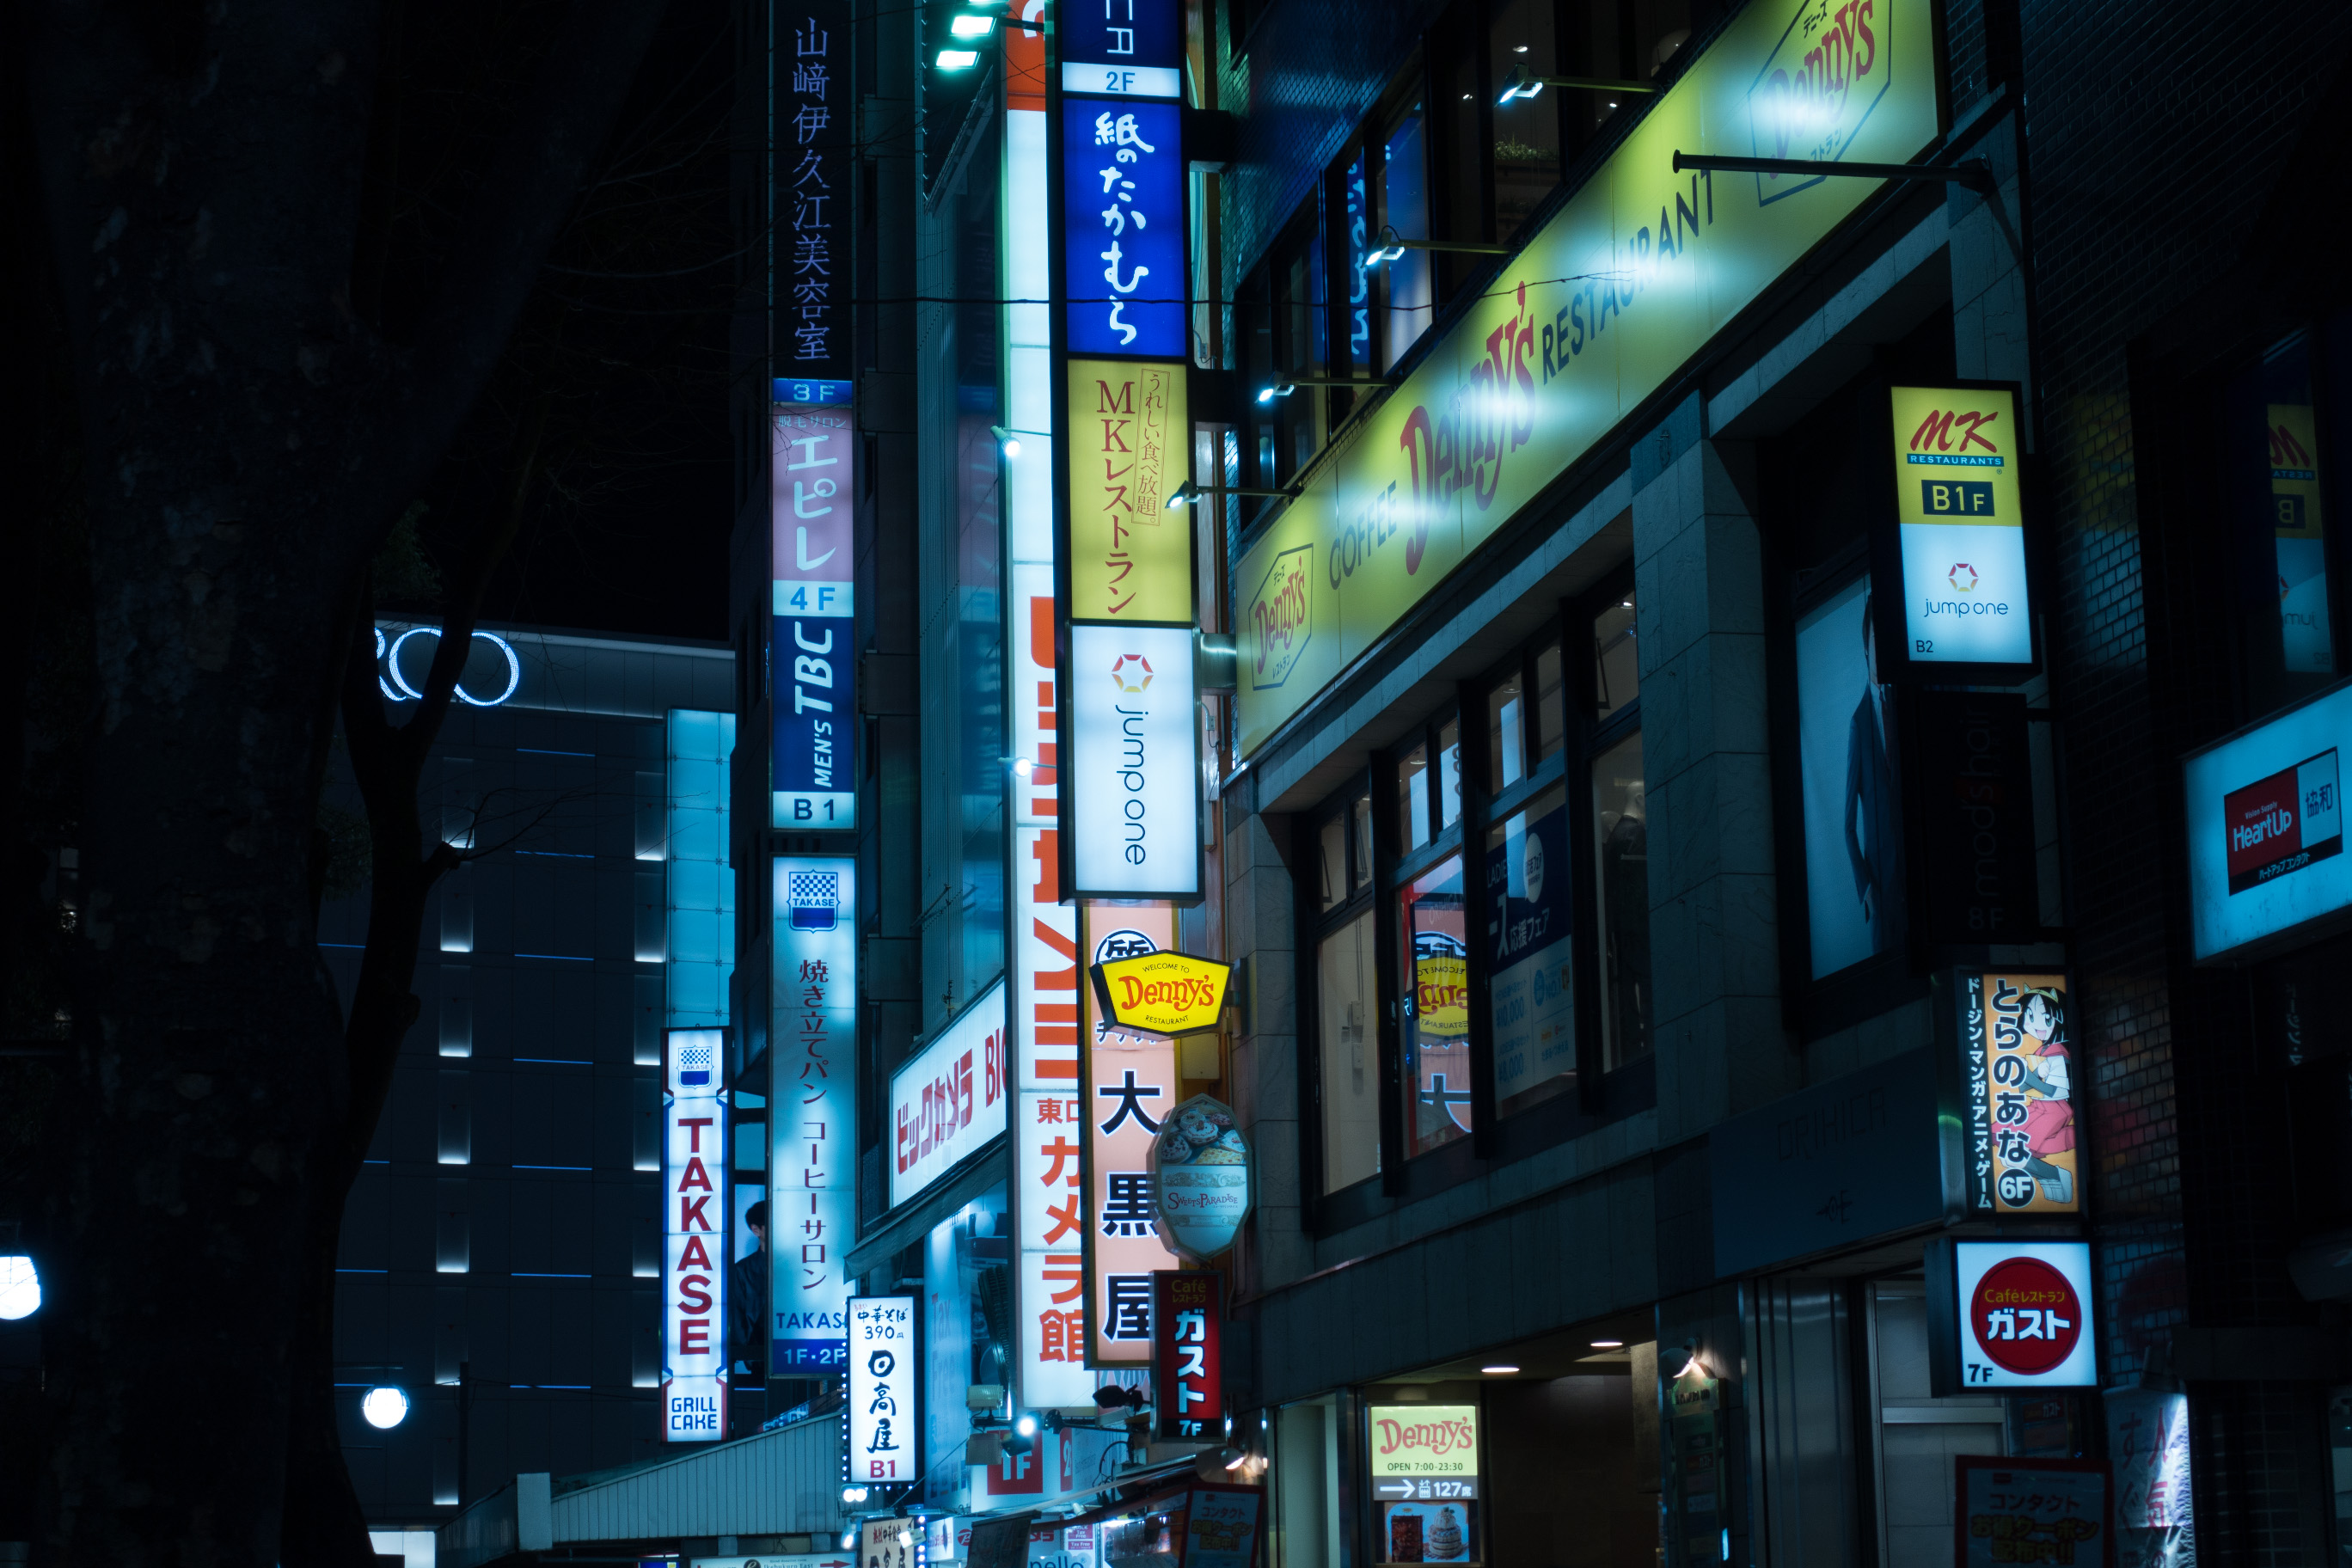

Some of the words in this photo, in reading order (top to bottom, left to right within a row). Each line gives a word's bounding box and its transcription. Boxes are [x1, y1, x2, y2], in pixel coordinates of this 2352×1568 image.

[1106, 70, 1136, 92] 2F
[1763, 0, 1876, 180] Dennys
[1094, 111, 1155, 346] 紙のたかむら
[793, 383, 836, 402] 3F
[1329, 480, 1397, 591] COFFEE
[1400, 280, 1536, 576] Denny's
[1541, 169, 1712, 386] RESTAURANT
[1909, 409, 2000, 453] MK
[1909, 455, 2002, 466] RESTAURANTS
[787, 435, 838, 571] エピレ
[1096, 379, 1136, 615] MKレストラン
[1932, 485, 1985, 511] B1F
[790, 586, 836, 611] 4F
[1924, 598, 1970, 618] jump
[1973, 602, 2009, 616] one
[1255, 555, 1306, 675] Denny's
[1916, 640, 1934, 653] B2
[793, 621, 834, 715] TBC
[814, 719, 833, 788] MEN'S
[1116, 703, 1149, 792] jump
[793, 798, 836, 821] B1
[2245, 808, 2261, 819] Vision
[2261, 800, 2278, 815] Supply
[2305, 783, 2332, 819] 協和
[1124, 799, 1147, 866] one
[792, 898, 835, 907] TAKASE
[1142, 962, 1178, 973] WELCOME
[1180, 965, 1190, 973] TO
[1118, 974, 1215, 1012] Denny's
[799, 959, 830, 1106] 焼き立てパン
[1144, 1014, 1190, 1026] RESTAURANT
[1990, 978, 2031, 1165] とらのあな
[897, 1047, 973, 1176] ビックカメラ
[2000, 1176, 2031, 1199] 6F
[799, 1122, 828, 1290] コーヒーサロン
[677, 1118, 714, 1356] TAKASE
[776, 1312, 847, 1330] TAKAS
[857, 1305, 908, 1324] 中華そば
[1988, 1308, 2071, 1341] ガスト
[1174, 1308, 1205, 1414] ガスト
[1967, 1363, 1994, 1383] 7F
[671, 1397, 718, 1412] GRILL
[867, 1349, 900, 1454] 日高屋
[671, 1415, 718, 1430] CAKE
[1179, 1419, 1203, 1436] 7F
[1375, 1416, 1473, 1455] Denny's
[870, 1459, 897, 1479] B1
[1387, 1462, 1411, 1471] OPEN
[1414, 1462, 1463, 1471] 7:00-23:30
[1988, 1493, 2080, 1513] コンタクト
